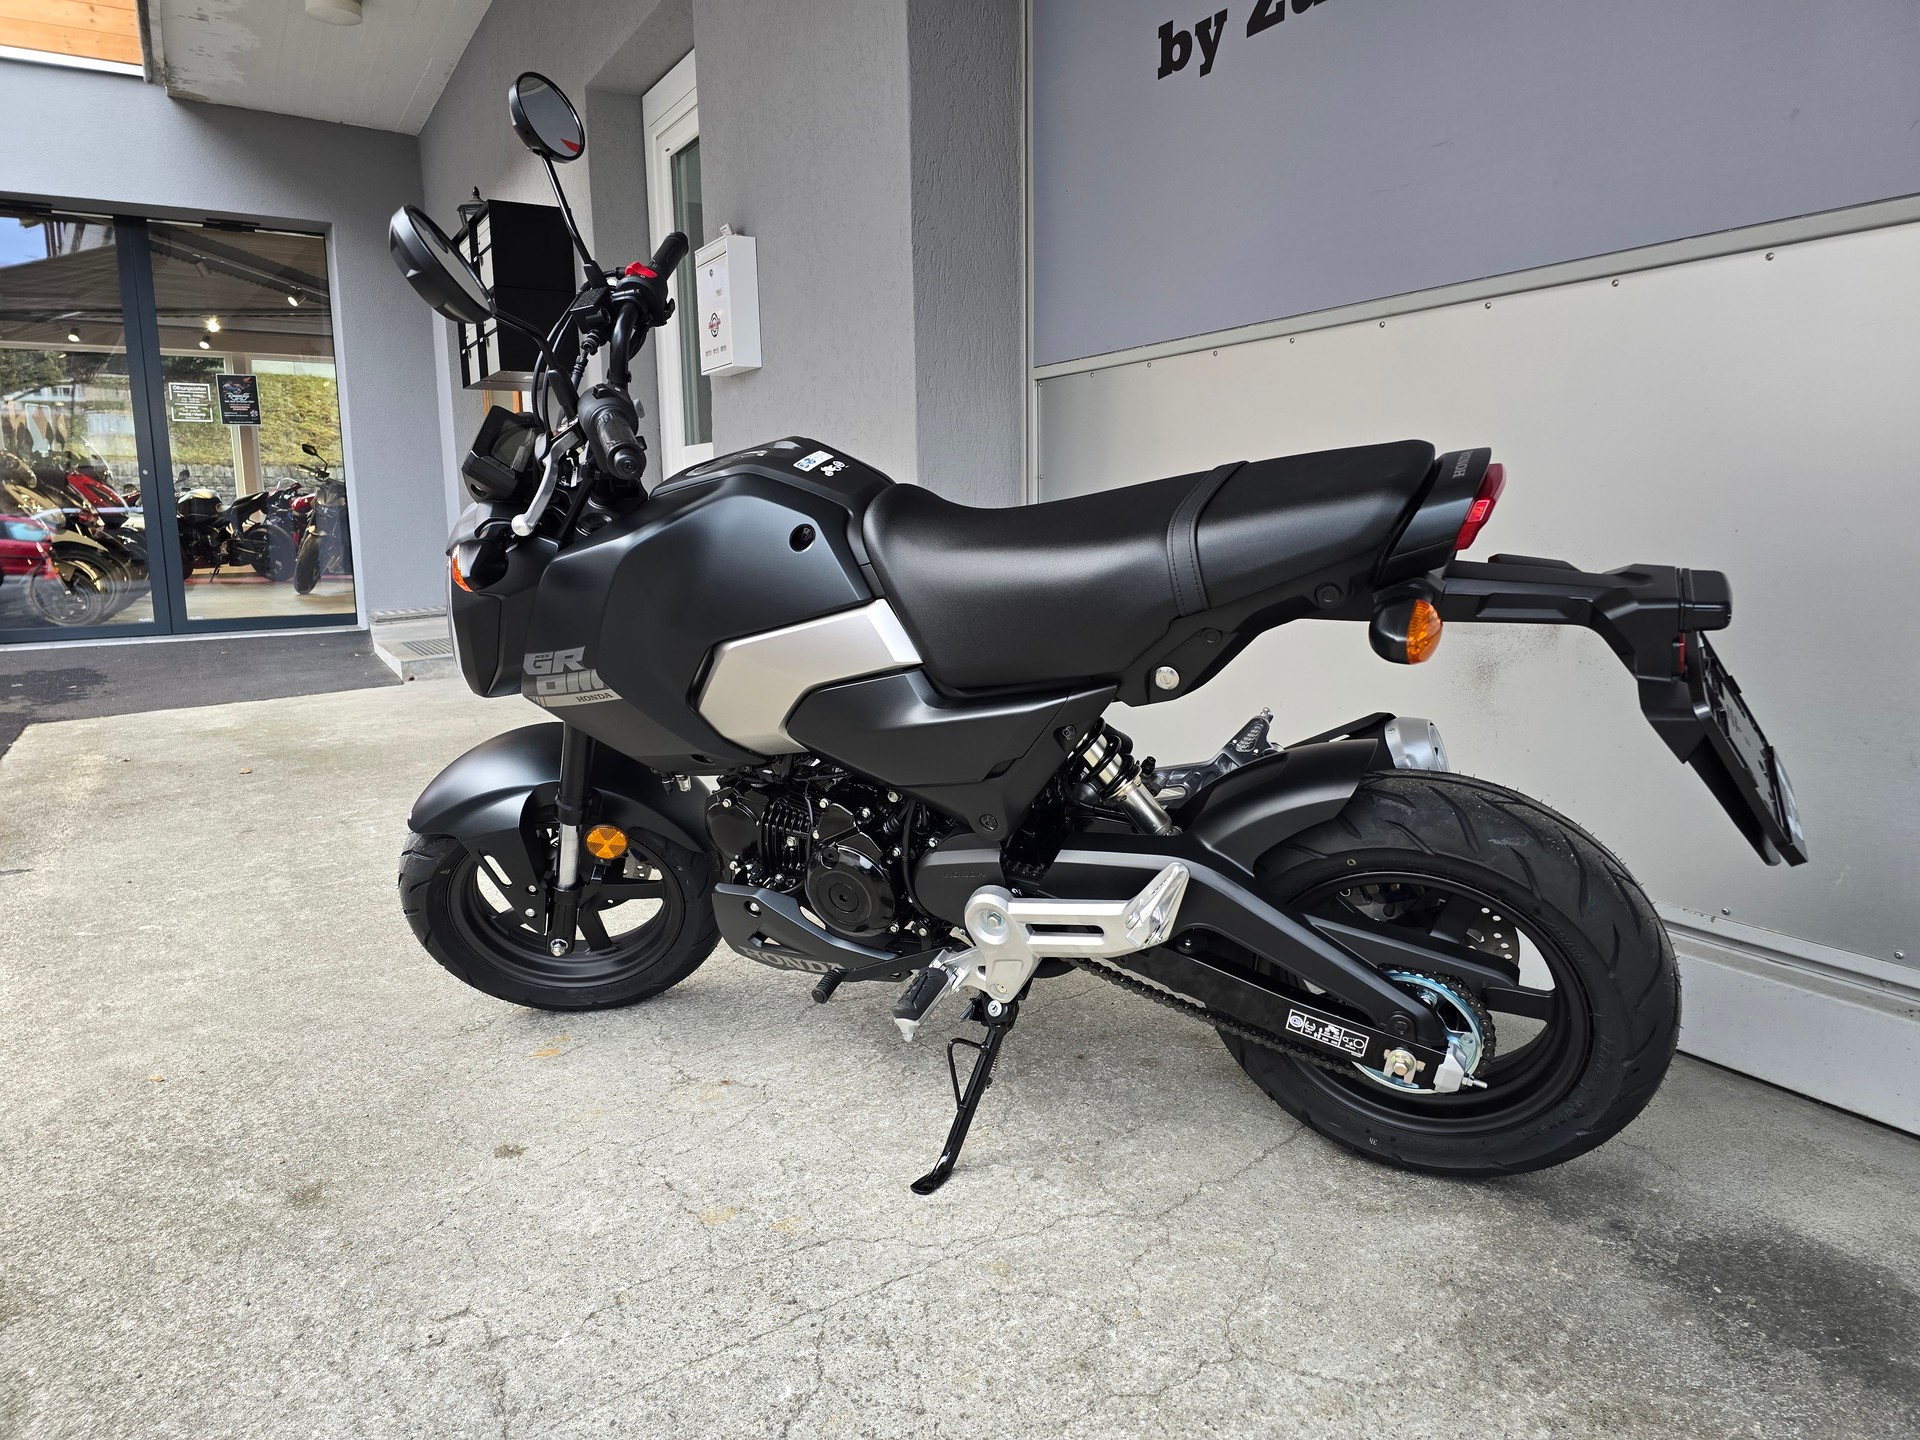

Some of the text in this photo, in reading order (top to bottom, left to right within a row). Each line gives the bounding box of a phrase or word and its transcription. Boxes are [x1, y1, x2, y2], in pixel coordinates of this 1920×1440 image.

[1157, 8, 1228, 80] by
[576, 693, 613, 702] HONDA
[943, 871, 987, 879] HONDA
